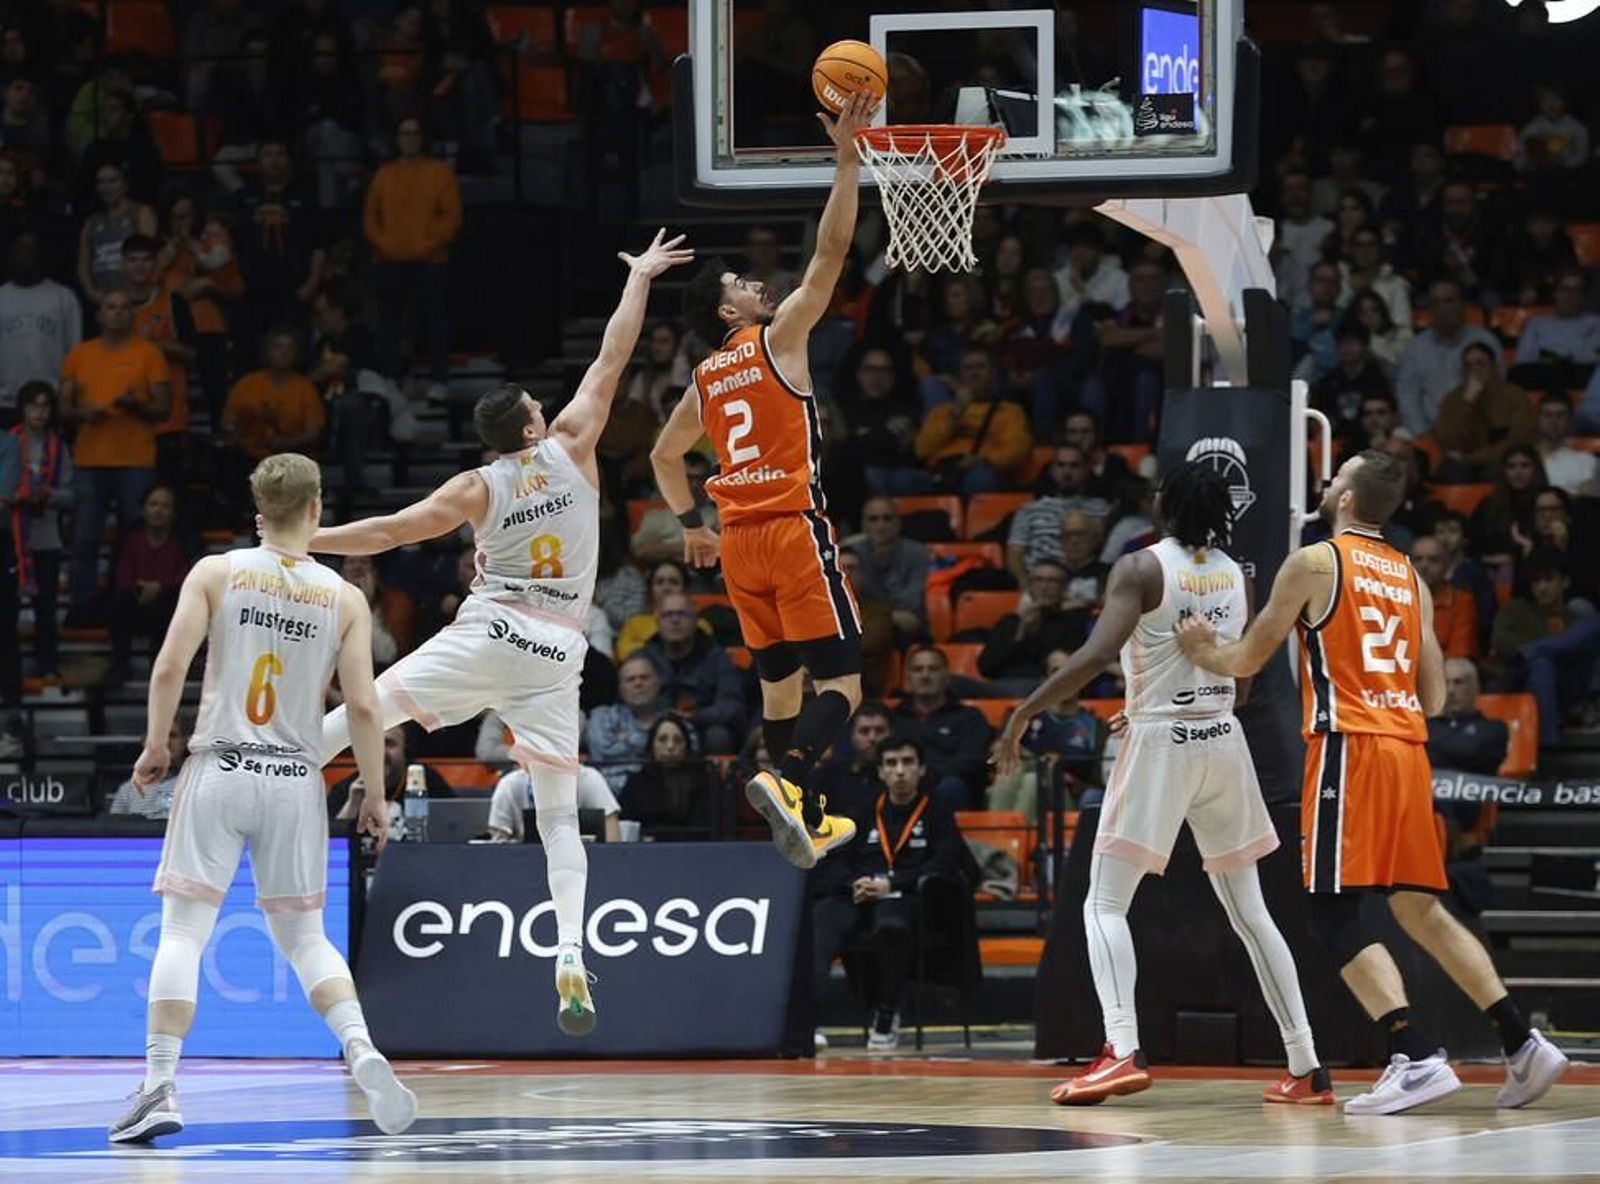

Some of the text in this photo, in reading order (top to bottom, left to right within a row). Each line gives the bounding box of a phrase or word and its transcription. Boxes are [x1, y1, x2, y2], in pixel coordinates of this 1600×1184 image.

[701, 341, 756, 376] PUERTO
[723, 398, 761, 467] 2
[529, 532, 564, 580] 8
[1351, 550, 1408, 579] COSTELLO
[507, 632, 567, 662] serveto
[1359, 605, 1411, 673] 24
[246, 652, 282, 726] 6
[242, 760, 308, 777] serveto
[7, 775, 65, 803] club
